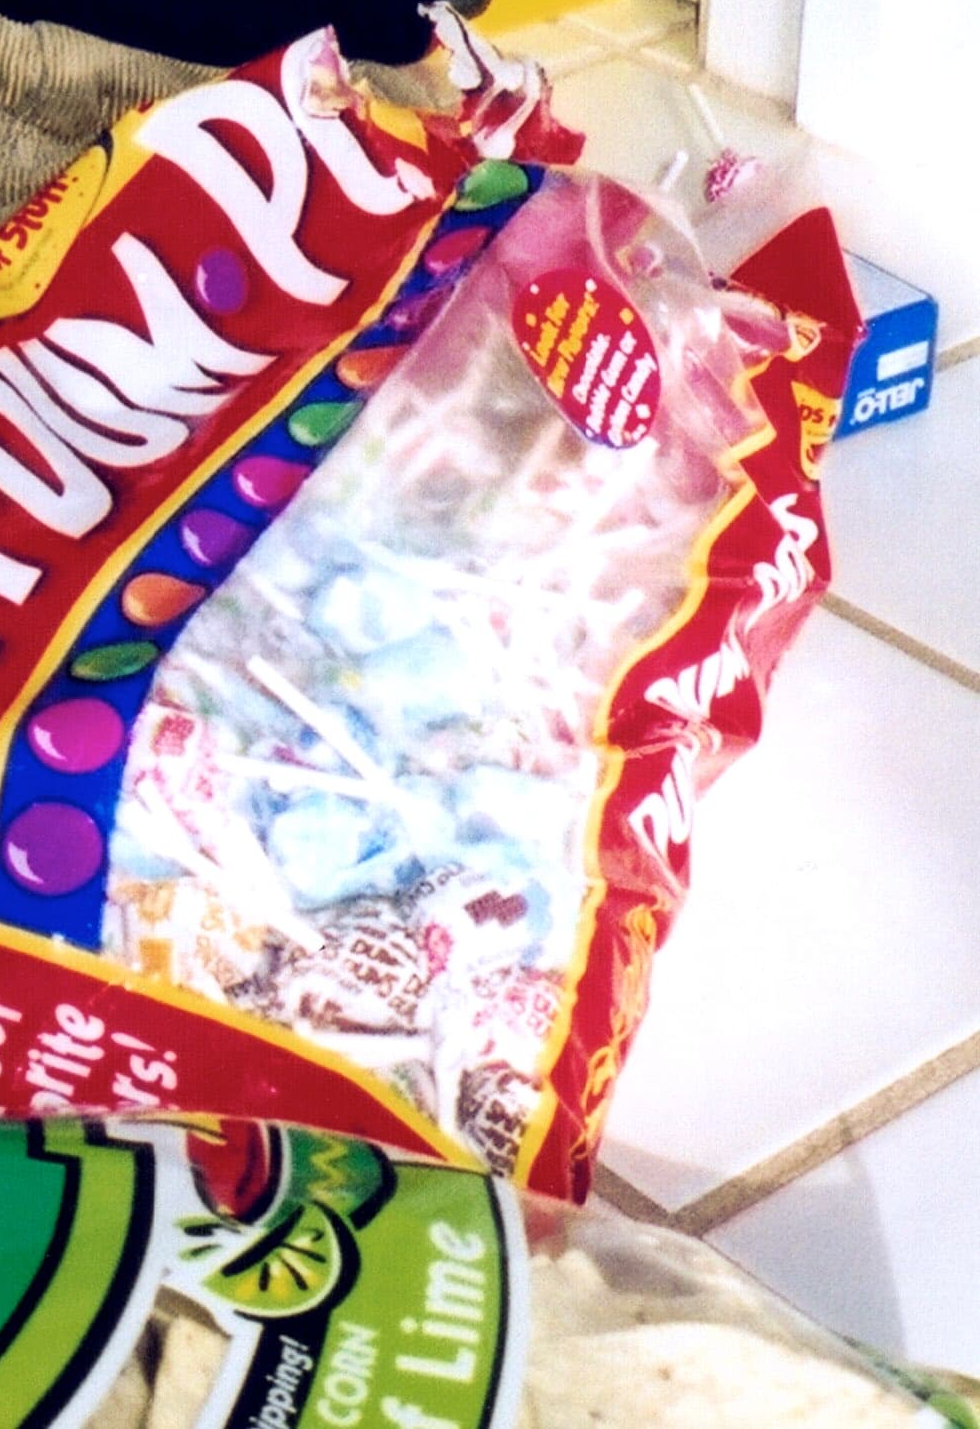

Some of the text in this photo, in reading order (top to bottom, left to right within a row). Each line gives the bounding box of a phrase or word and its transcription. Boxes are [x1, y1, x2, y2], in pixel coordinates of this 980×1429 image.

[620, 351, 658, 404] Candy
[393, 1219, 488, 1383] Lime
[245, 1334, 315, 1429] ipping!
[316, 1320, 381, 1428] CORN
